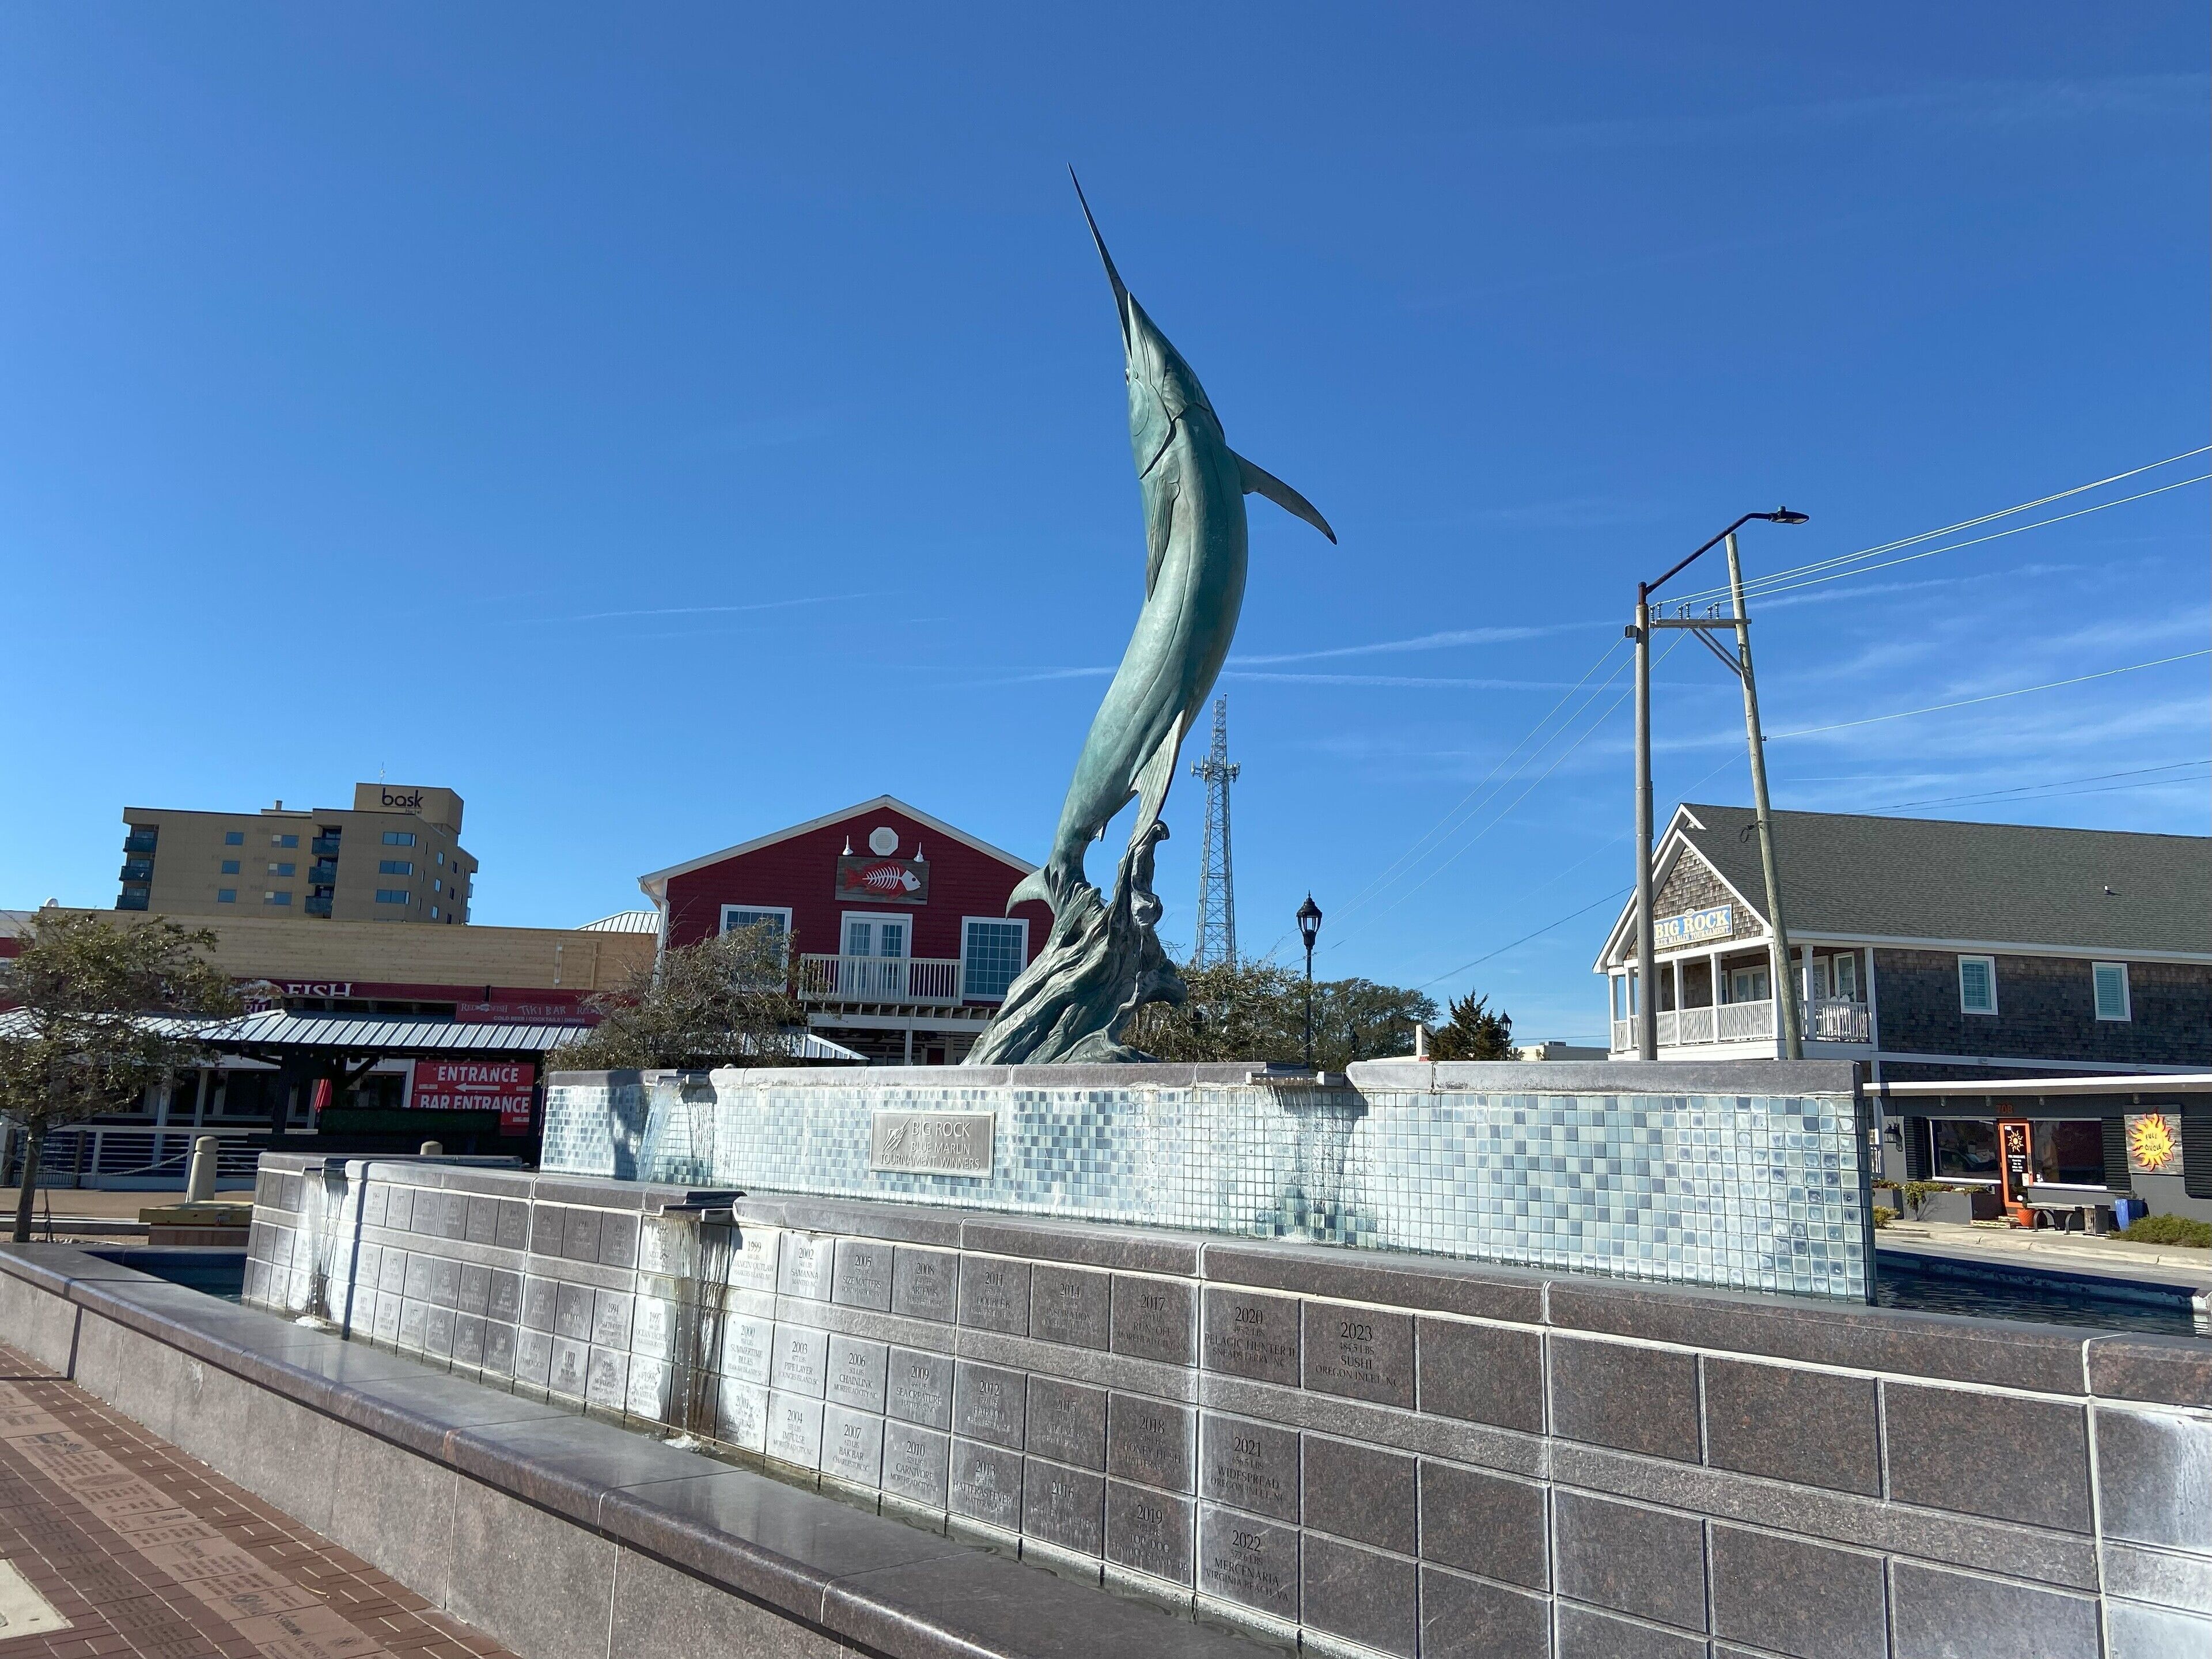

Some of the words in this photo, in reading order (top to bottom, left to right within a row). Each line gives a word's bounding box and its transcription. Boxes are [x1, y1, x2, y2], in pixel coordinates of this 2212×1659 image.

[381, 787, 424, 808] bask
[1654, 921, 1680, 940] BIG
[1683, 910, 1728, 934] ROCK
[287, 983, 353, 997] FISH
[546, 1006, 566, 1015] BAR
[438, 1066, 518, 1083] ENTRANCE
[421, 1095, 450, 1109] BAR
[453, 1095, 531, 1113] ENTRANCE
[912, 1121, 932, 1137] BIG
[935, 1122, 971, 1138] ROCK
[911, 1142, 931, 1153] BLUE
[934, 1143, 970, 1155] MARLIN
[2145, 1143, 2162, 1152] CIRCLE
[880, 1154, 937, 1168] TOURNAMENT
[940, 1157, 980, 1169] WINNERS
[748, 1241, 762, 1253] 1999
[798, 1248, 814, 1260] 2002
[753, 1262, 775, 1272] OUTLAW
[855, 1255, 872, 1267] 2005
[916, 1262, 934, 1276] 2008
[791, 1268, 819, 1279] SAMANNA
[984, 1271, 1003, 1286] 2011
[843, 1275, 855, 1285] SIZE
[856, 1277, 881, 1289] MATTERS
[911, 1286, 938, 1297] ARTEMIS
[1060, 1283, 1081, 1298] 2014
[1141, 1294, 1165, 1310] 2017
[1235, 1306, 1263, 1325] 2020
[741, 1325, 756, 1338] 2000
[1340, 1321, 1373, 1342] 2023
[791, 1340, 808, 1355] 2003
[1205, 1333, 1243, 1350] PELAGIC
[1246, 1338, 1286, 1356] HUNTER
[1359, 1344, 1376, 1355] LBS
[849, 1352, 866, 1367] 2006
[1213, 1347, 1243, 1359] SNEADS
[1273, 1357, 1286, 1368] NC
[1341, 1354, 1372, 1370] SUSHI
[796, 1364, 813, 1376] LAYER
[911, 1365, 929, 1381] 2009
[1315, 1364, 1353, 1379] OREGON
[1386, 1377, 1398, 1387] NC
[834, 1383, 858, 1395] MOREHEAD
[839, 1374, 873, 1389] CHAINLINK
[980, 1380, 999, 1396] 2012
[896, 1387, 908, 1397] SEA
[909, 1389, 942, 1405] CREATURE
[1056, 1397, 1077, 1413] 2015
[787, 1410, 802, 1424] 2004
[1140, 1415, 1164, 1434] 2018
[844, 1423, 862, 1439] 2007
[906, 1441, 925, 1457] 2010
[1123, 1441, 1153, 1457] HONEY
[1157, 1448, 1181, 1464] HUSH
[1234, 1436, 1260, 1457] 2021
[896, 1463, 933, 1481] CARNIVORE
[976, 1460, 996, 1477] 2013
[1251, 1460, 1264, 1470] LBS
[1210, 1477, 1244, 1493] OREGON
[1217, 1464, 1279, 1490] WIDESPREAD
[953, 1479, 988, 1498] HATTERAS
[990, 1490, 1012, 1505] FEVER
[1051, 1480, 1074, 1499] 2016
[1137, 1504, 1163, 1525] 2019
[1130, 1533, 1145, 1546] TOP
[1150, 1539, 1170, 1554] DOG
[1232, 1530, 1261, 1552] 2022
[1249, 1554, 1263, 1566] LBS
[1214, 1556, 1279, 1587] MERCENARIA
[1206, 1568, 1243, 1588] VIRGINIA
[1277, 1590, 1289, 1602] VA
